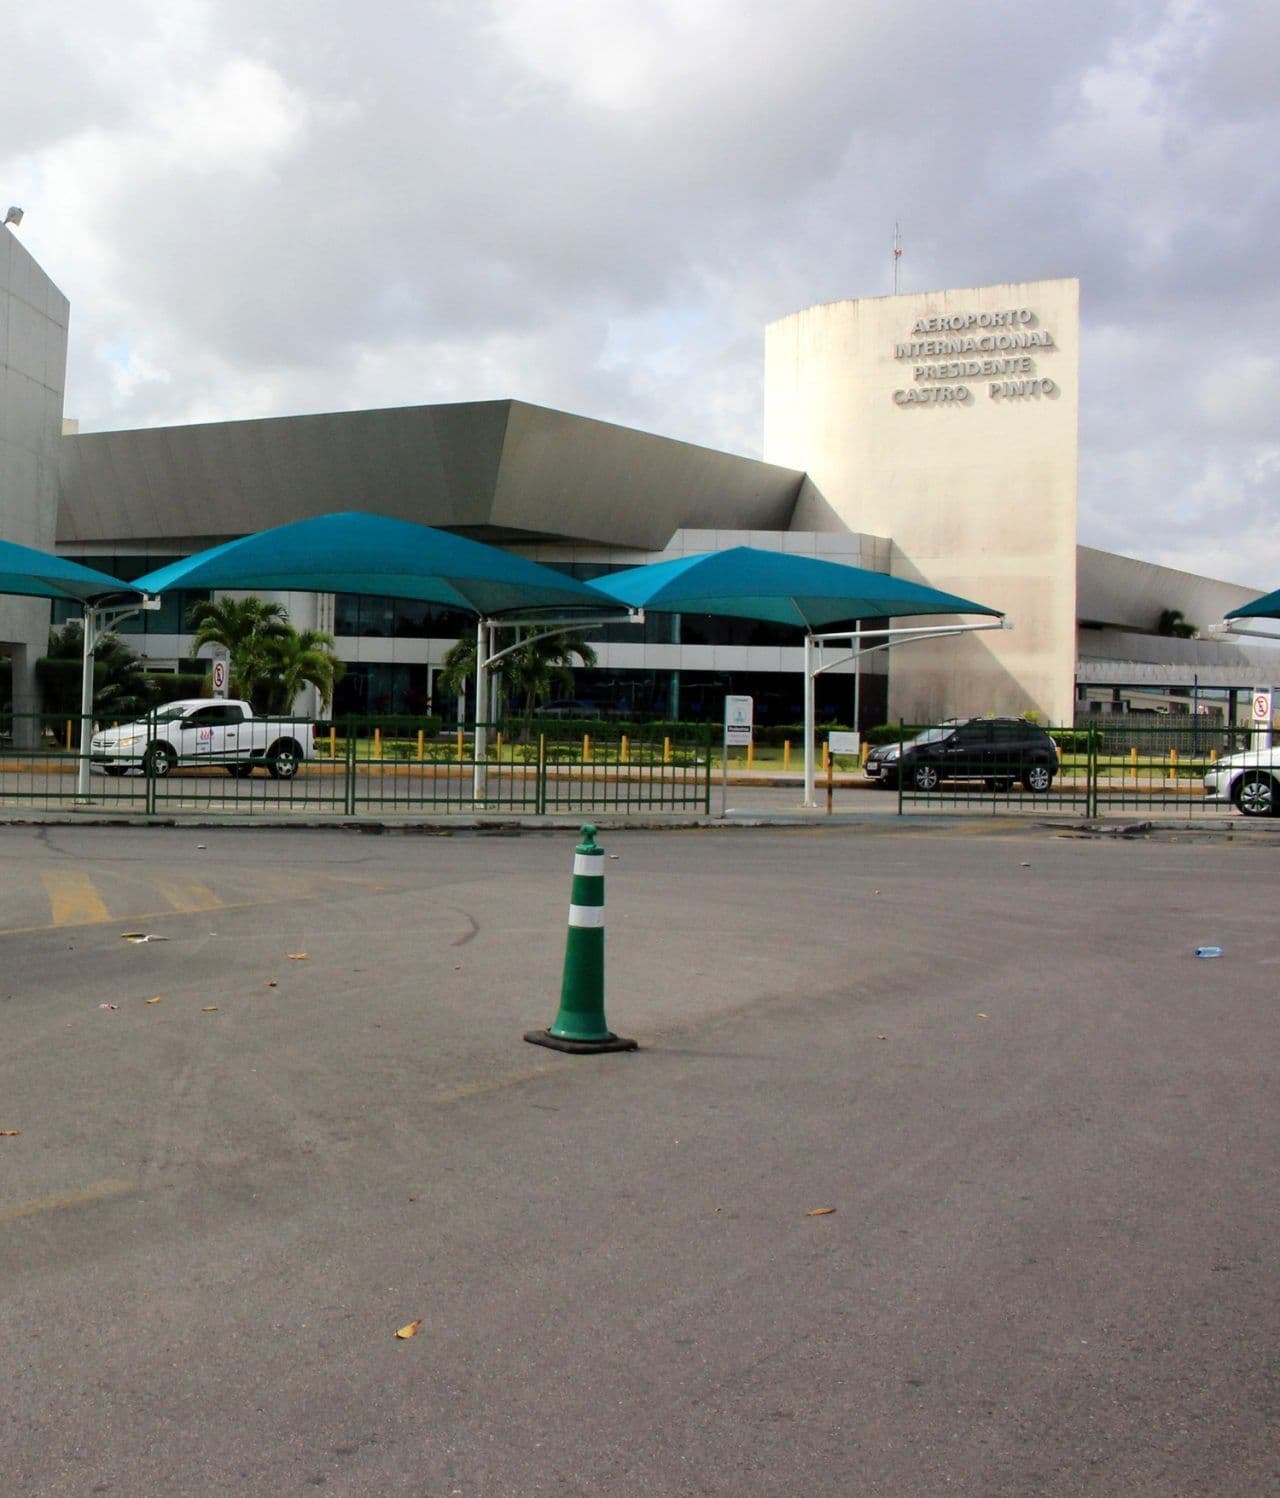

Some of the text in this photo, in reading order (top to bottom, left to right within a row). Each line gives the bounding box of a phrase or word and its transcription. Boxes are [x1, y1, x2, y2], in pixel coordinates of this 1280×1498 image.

[912, 308, 1034, 335] AEROPORTO
[894, 331, 1055, 359] INTERNACIONAL
[913, 357, 1032, 381] PRESIDENTE
[892, 377, 1056, 405] CASTRO PINTO
